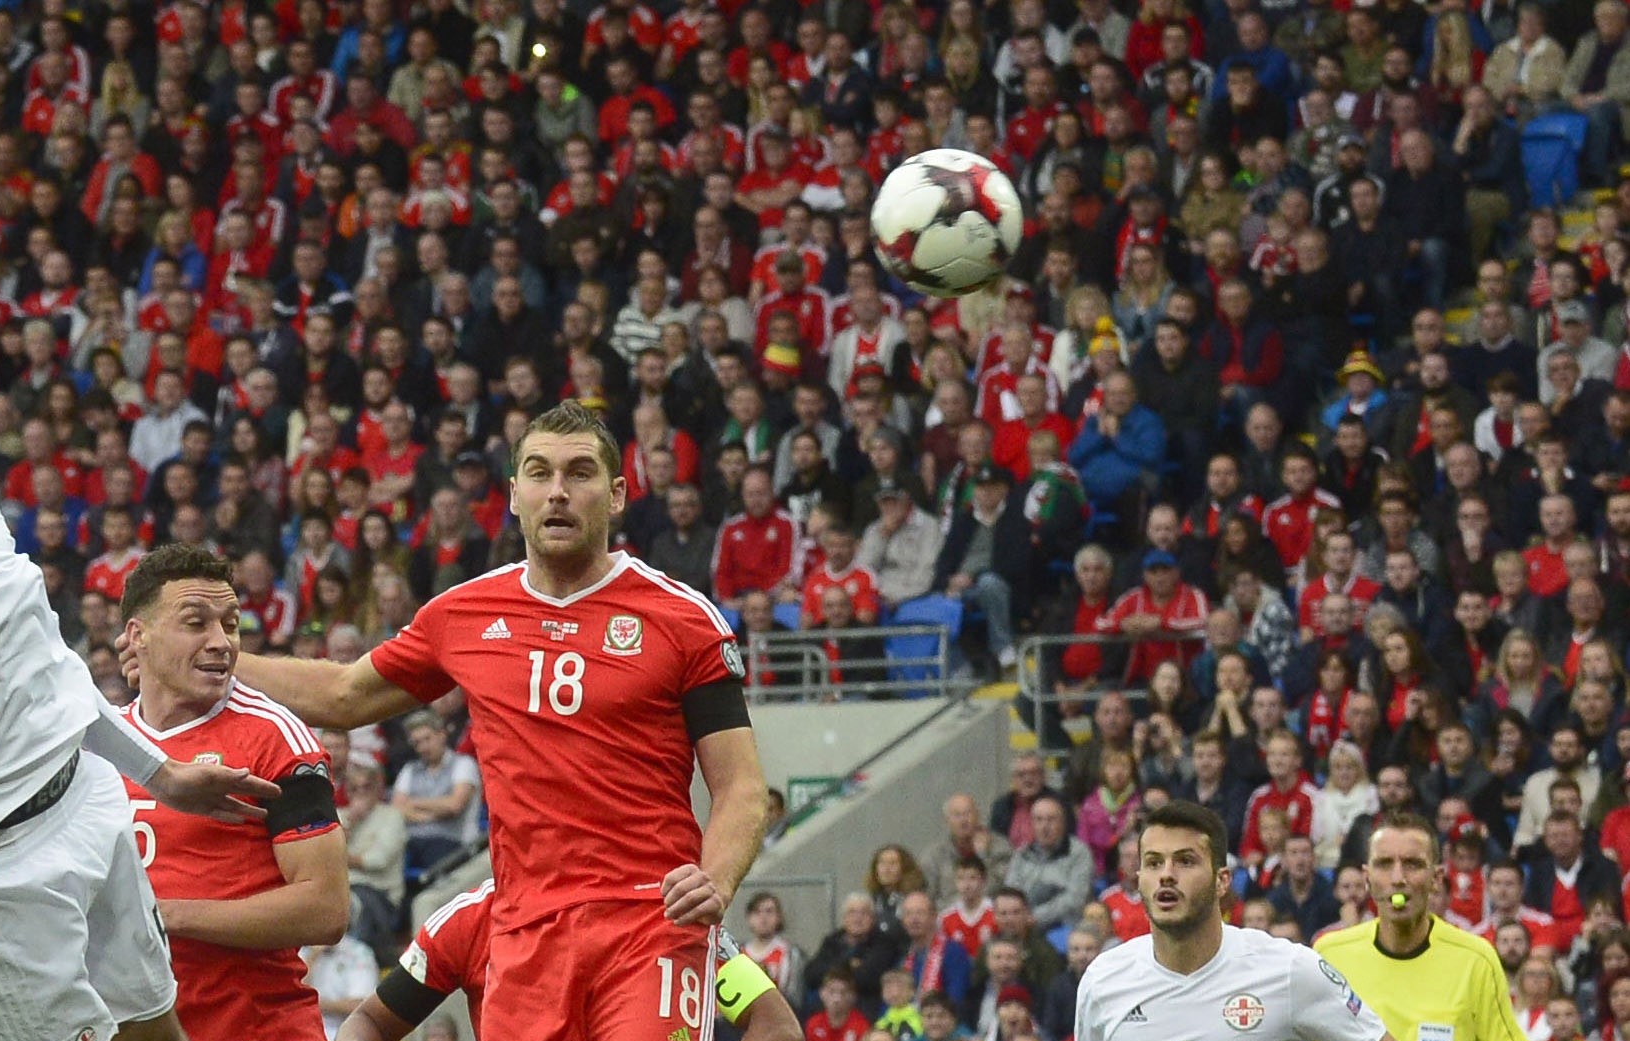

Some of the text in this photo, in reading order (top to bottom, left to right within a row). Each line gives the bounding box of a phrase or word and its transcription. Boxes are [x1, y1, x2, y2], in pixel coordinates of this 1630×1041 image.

[527, 650, 586, 716] 18
[129, 800, 157, 869] 5
[657, 957, 701, 1029] 18
[715, 978, 742, 1008] C
[1224, 1007, 1265, 1018] Georgia
